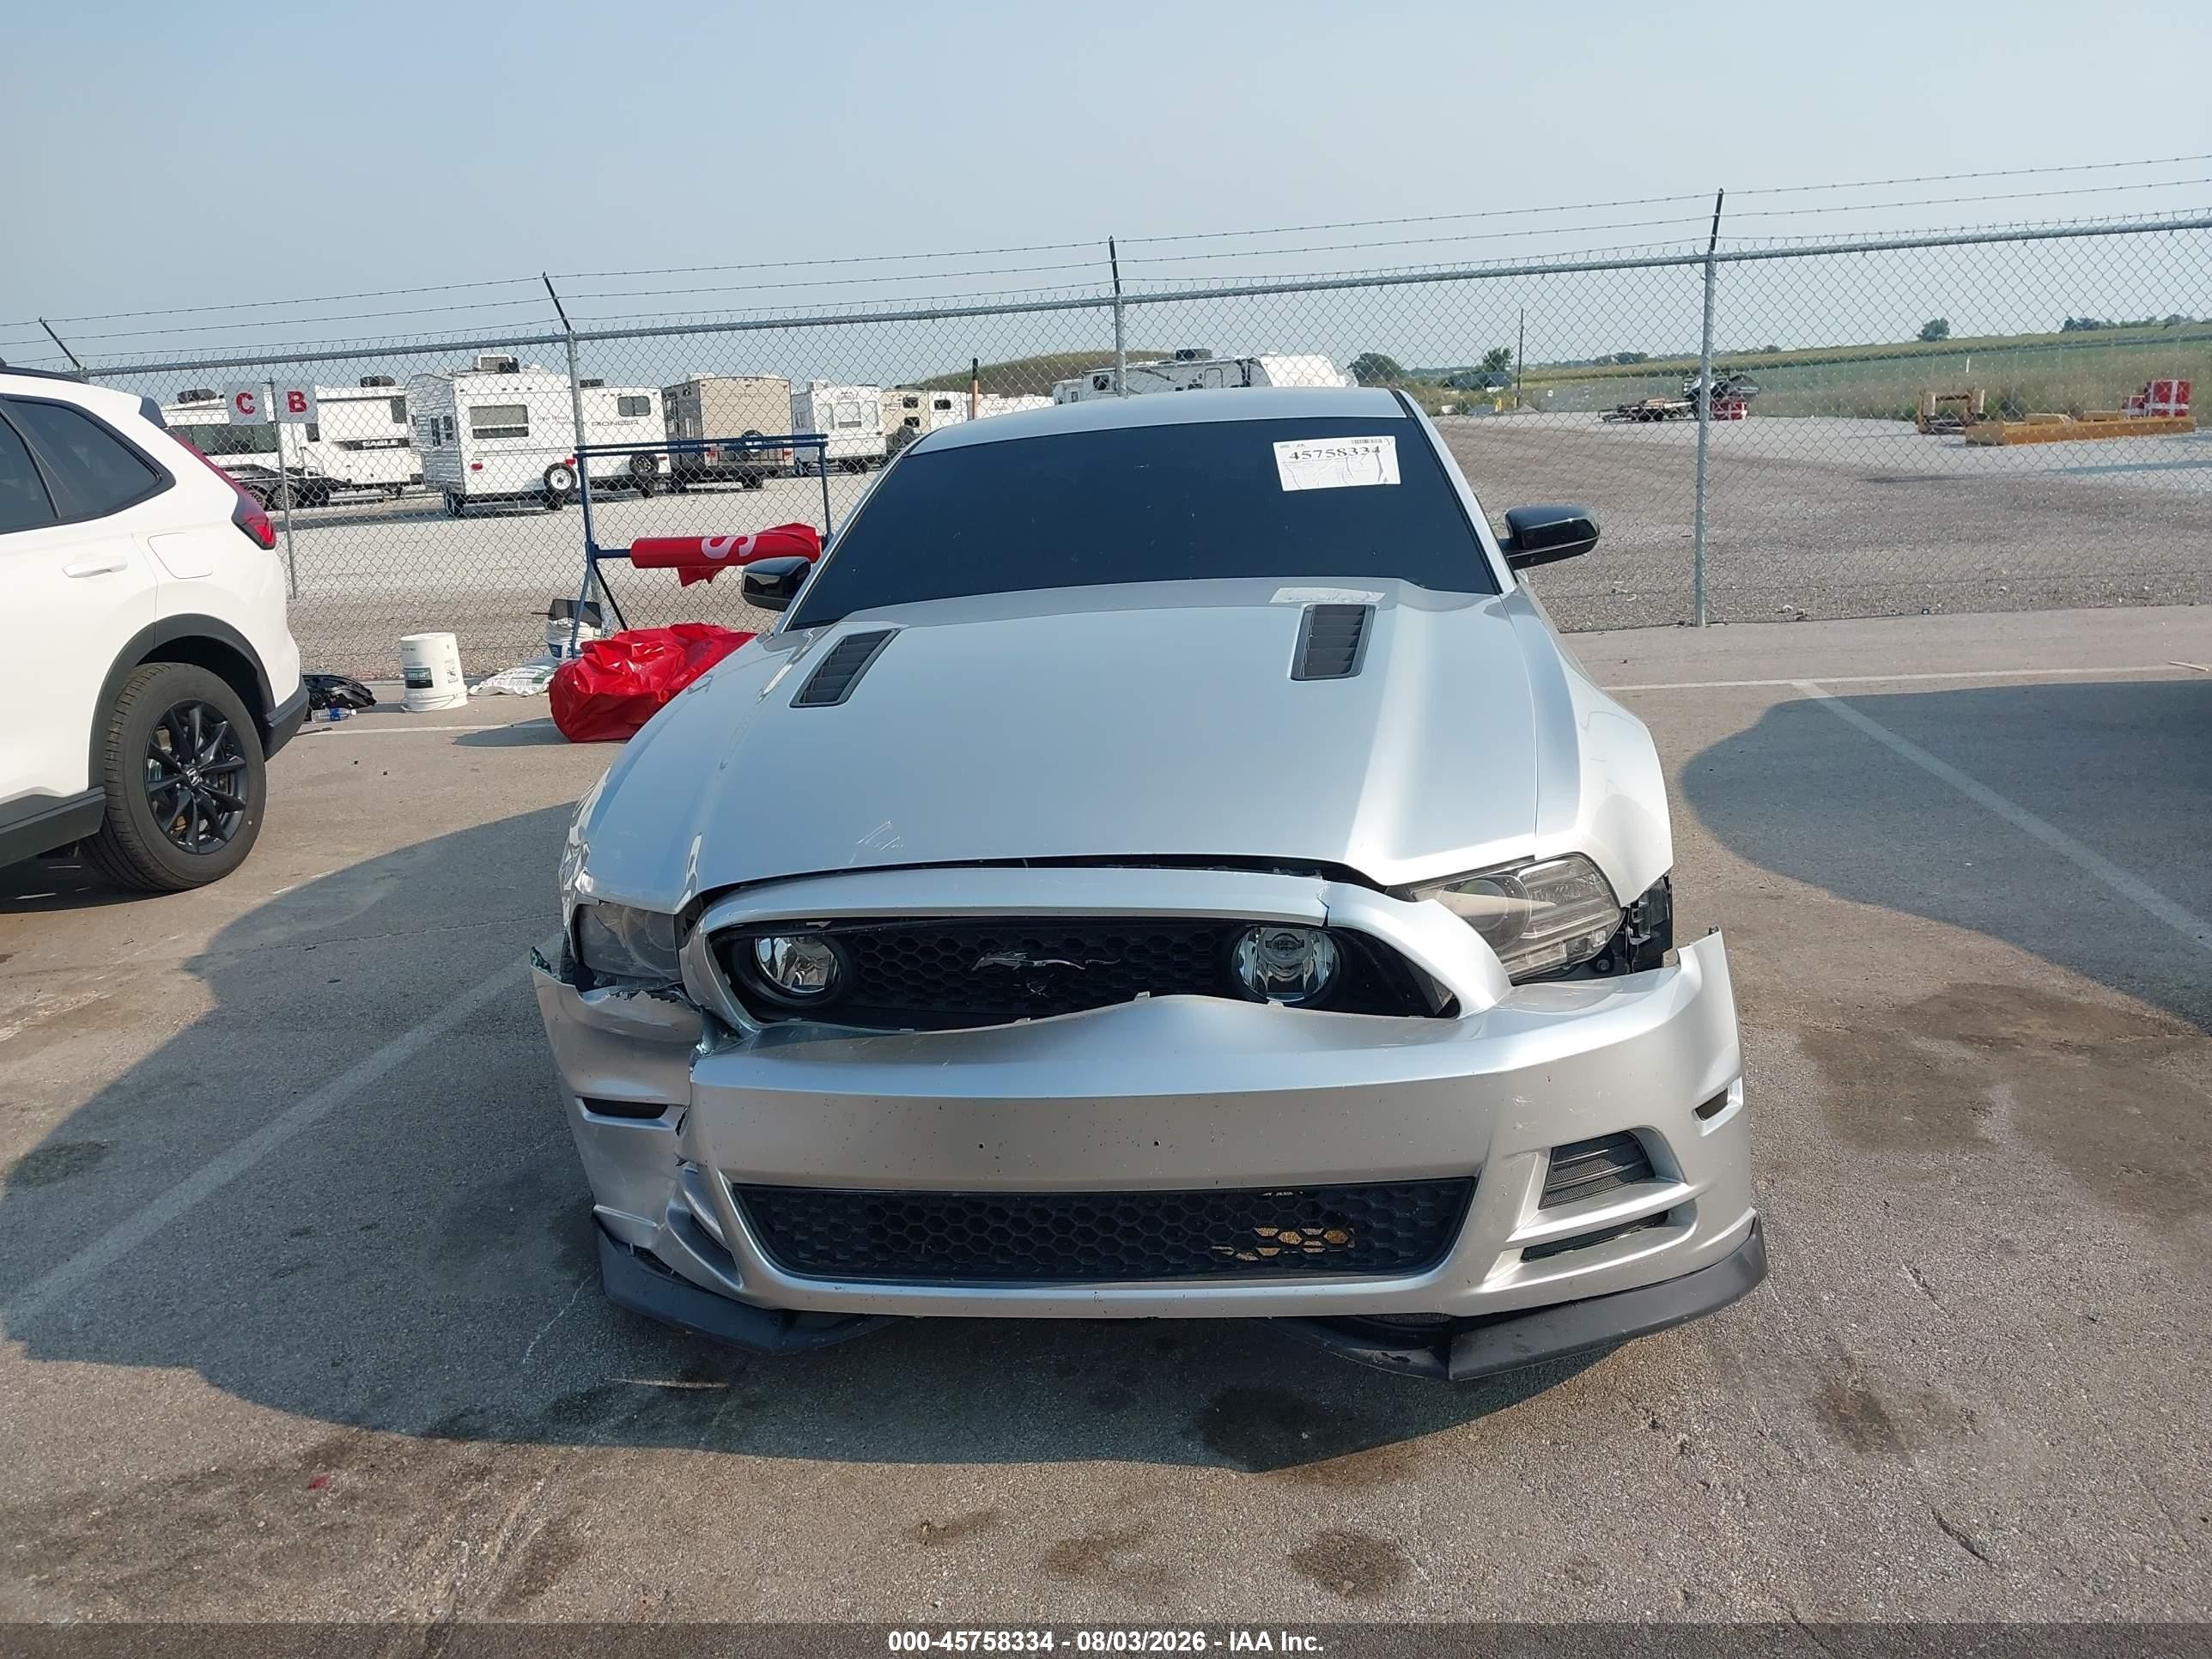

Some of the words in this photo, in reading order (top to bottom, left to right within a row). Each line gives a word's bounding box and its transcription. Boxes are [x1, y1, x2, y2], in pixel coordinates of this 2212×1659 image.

[235, 392, 256, 415] C
[288, 392, 307, 413] B
[1289, 446, 1381, 460] 45758334
